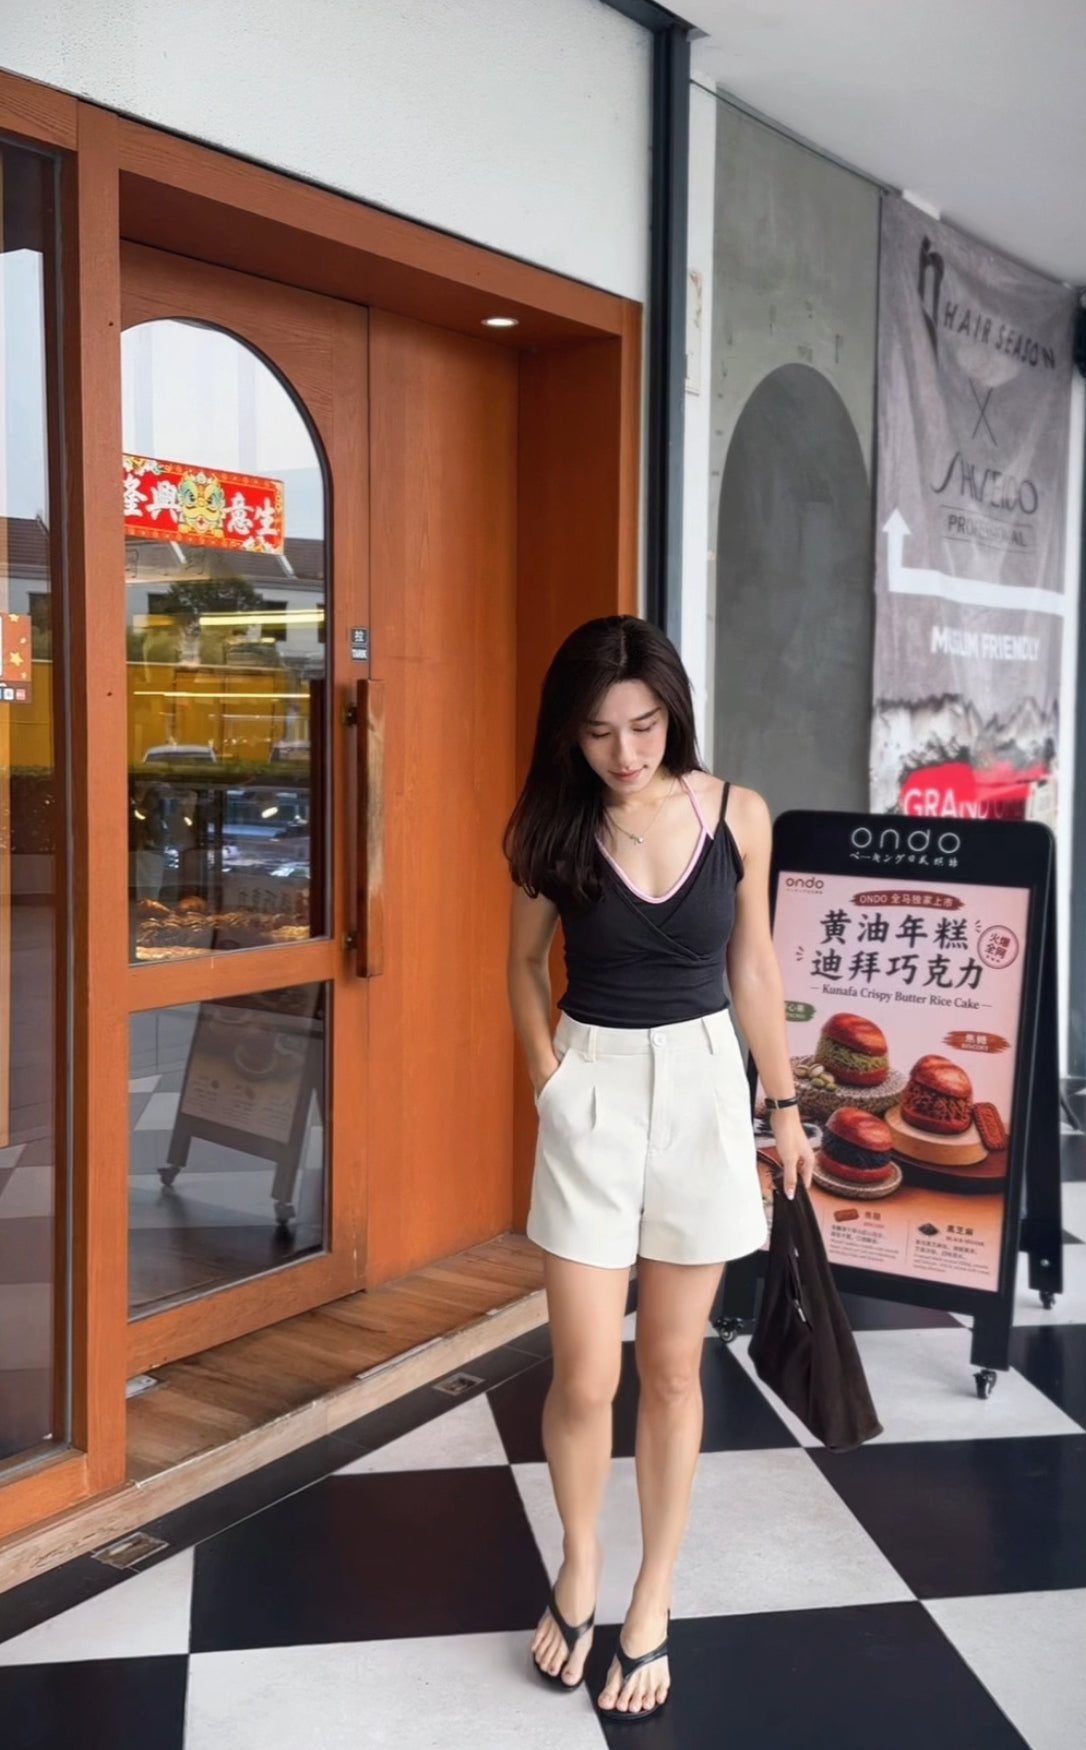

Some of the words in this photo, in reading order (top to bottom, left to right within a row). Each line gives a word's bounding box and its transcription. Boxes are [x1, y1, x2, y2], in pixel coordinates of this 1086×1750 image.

[943, 302, 993, 344] HAIR
[995, 324, 1056, 369] SEASON
[851, 827, 960, 854] ondo
[785, 877, 824, 890] ondo
[859, 894, 888, 904] ONDO
[820, 909, 969, 950] 黄油年糕
[809, 948, 984, 990] 迪拜巧克力
[822, 983, 858, 997] Kunafa
[860, 987, 892, 1003] Crispy
[894, 991, 927, 1006] Butter
[929, 995, 953, 1009] Rice
[953, 998, 981, 1010] Cake
